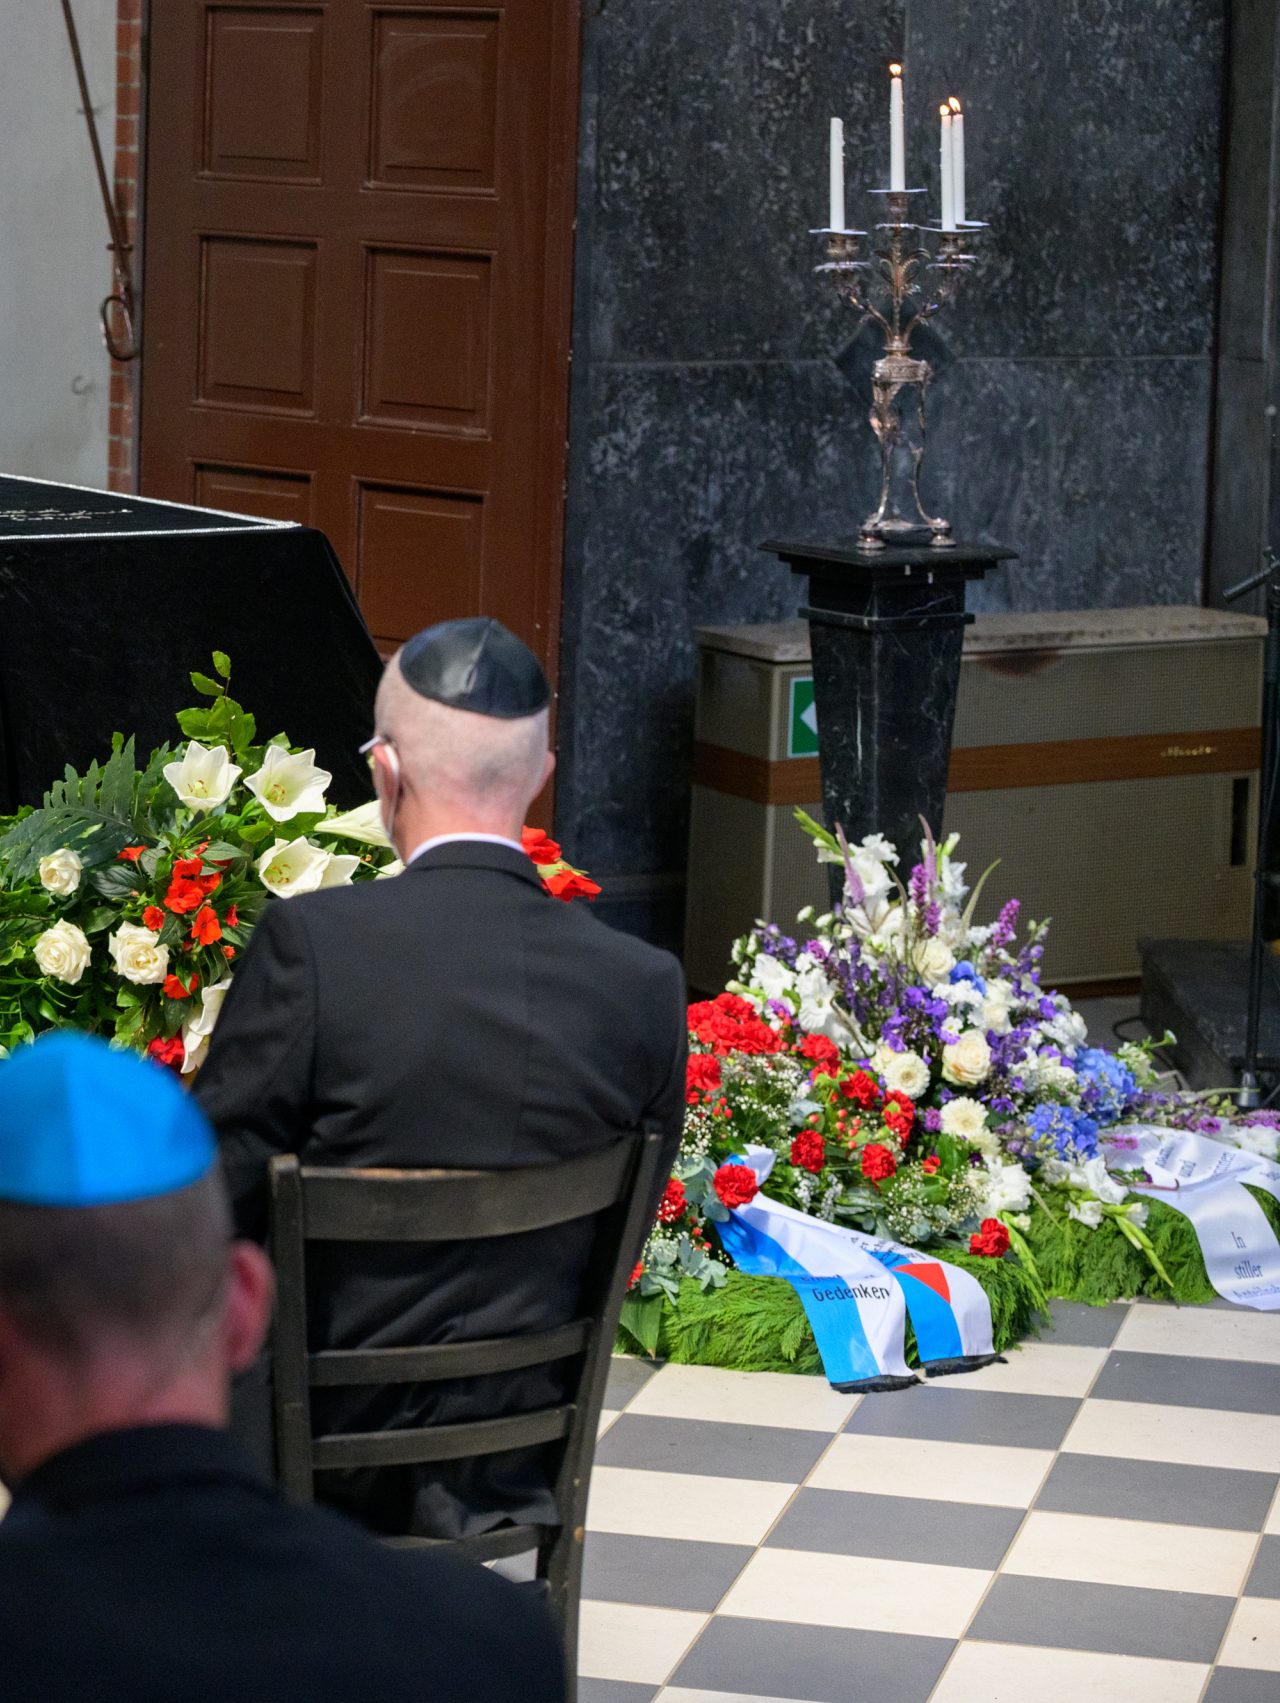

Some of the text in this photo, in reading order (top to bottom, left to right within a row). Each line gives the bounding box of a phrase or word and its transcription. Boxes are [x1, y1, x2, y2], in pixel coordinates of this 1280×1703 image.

[1231, 1231, 1246, 1249] In
[1234, 1260, 1263, 1279] stiller
[812, 1283, 890, 1302] Gedenken
